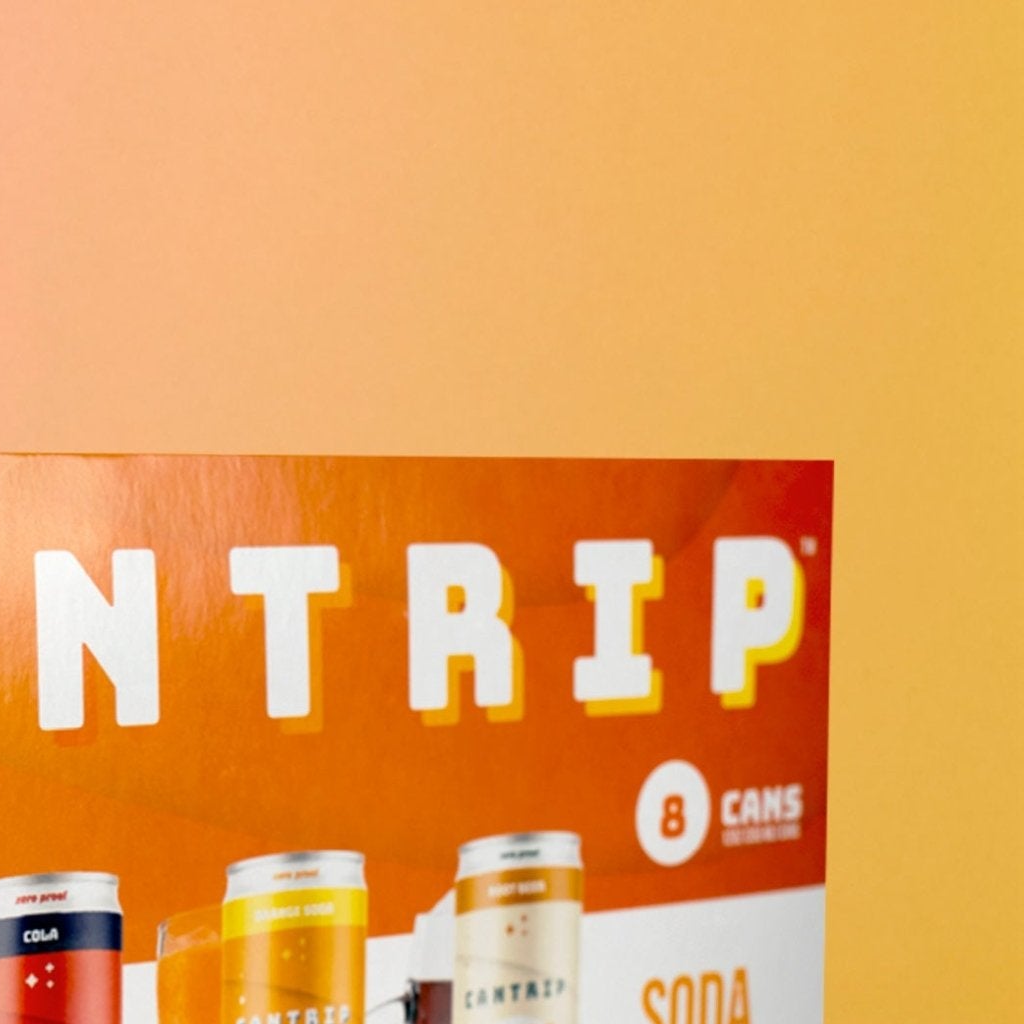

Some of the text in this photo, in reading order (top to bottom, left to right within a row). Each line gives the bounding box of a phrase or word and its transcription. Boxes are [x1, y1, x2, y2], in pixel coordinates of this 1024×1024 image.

[659, 794, 686, 839] 8
[721, 783, 803, 826] CANS
[23, 927, 59, 943] COLA
